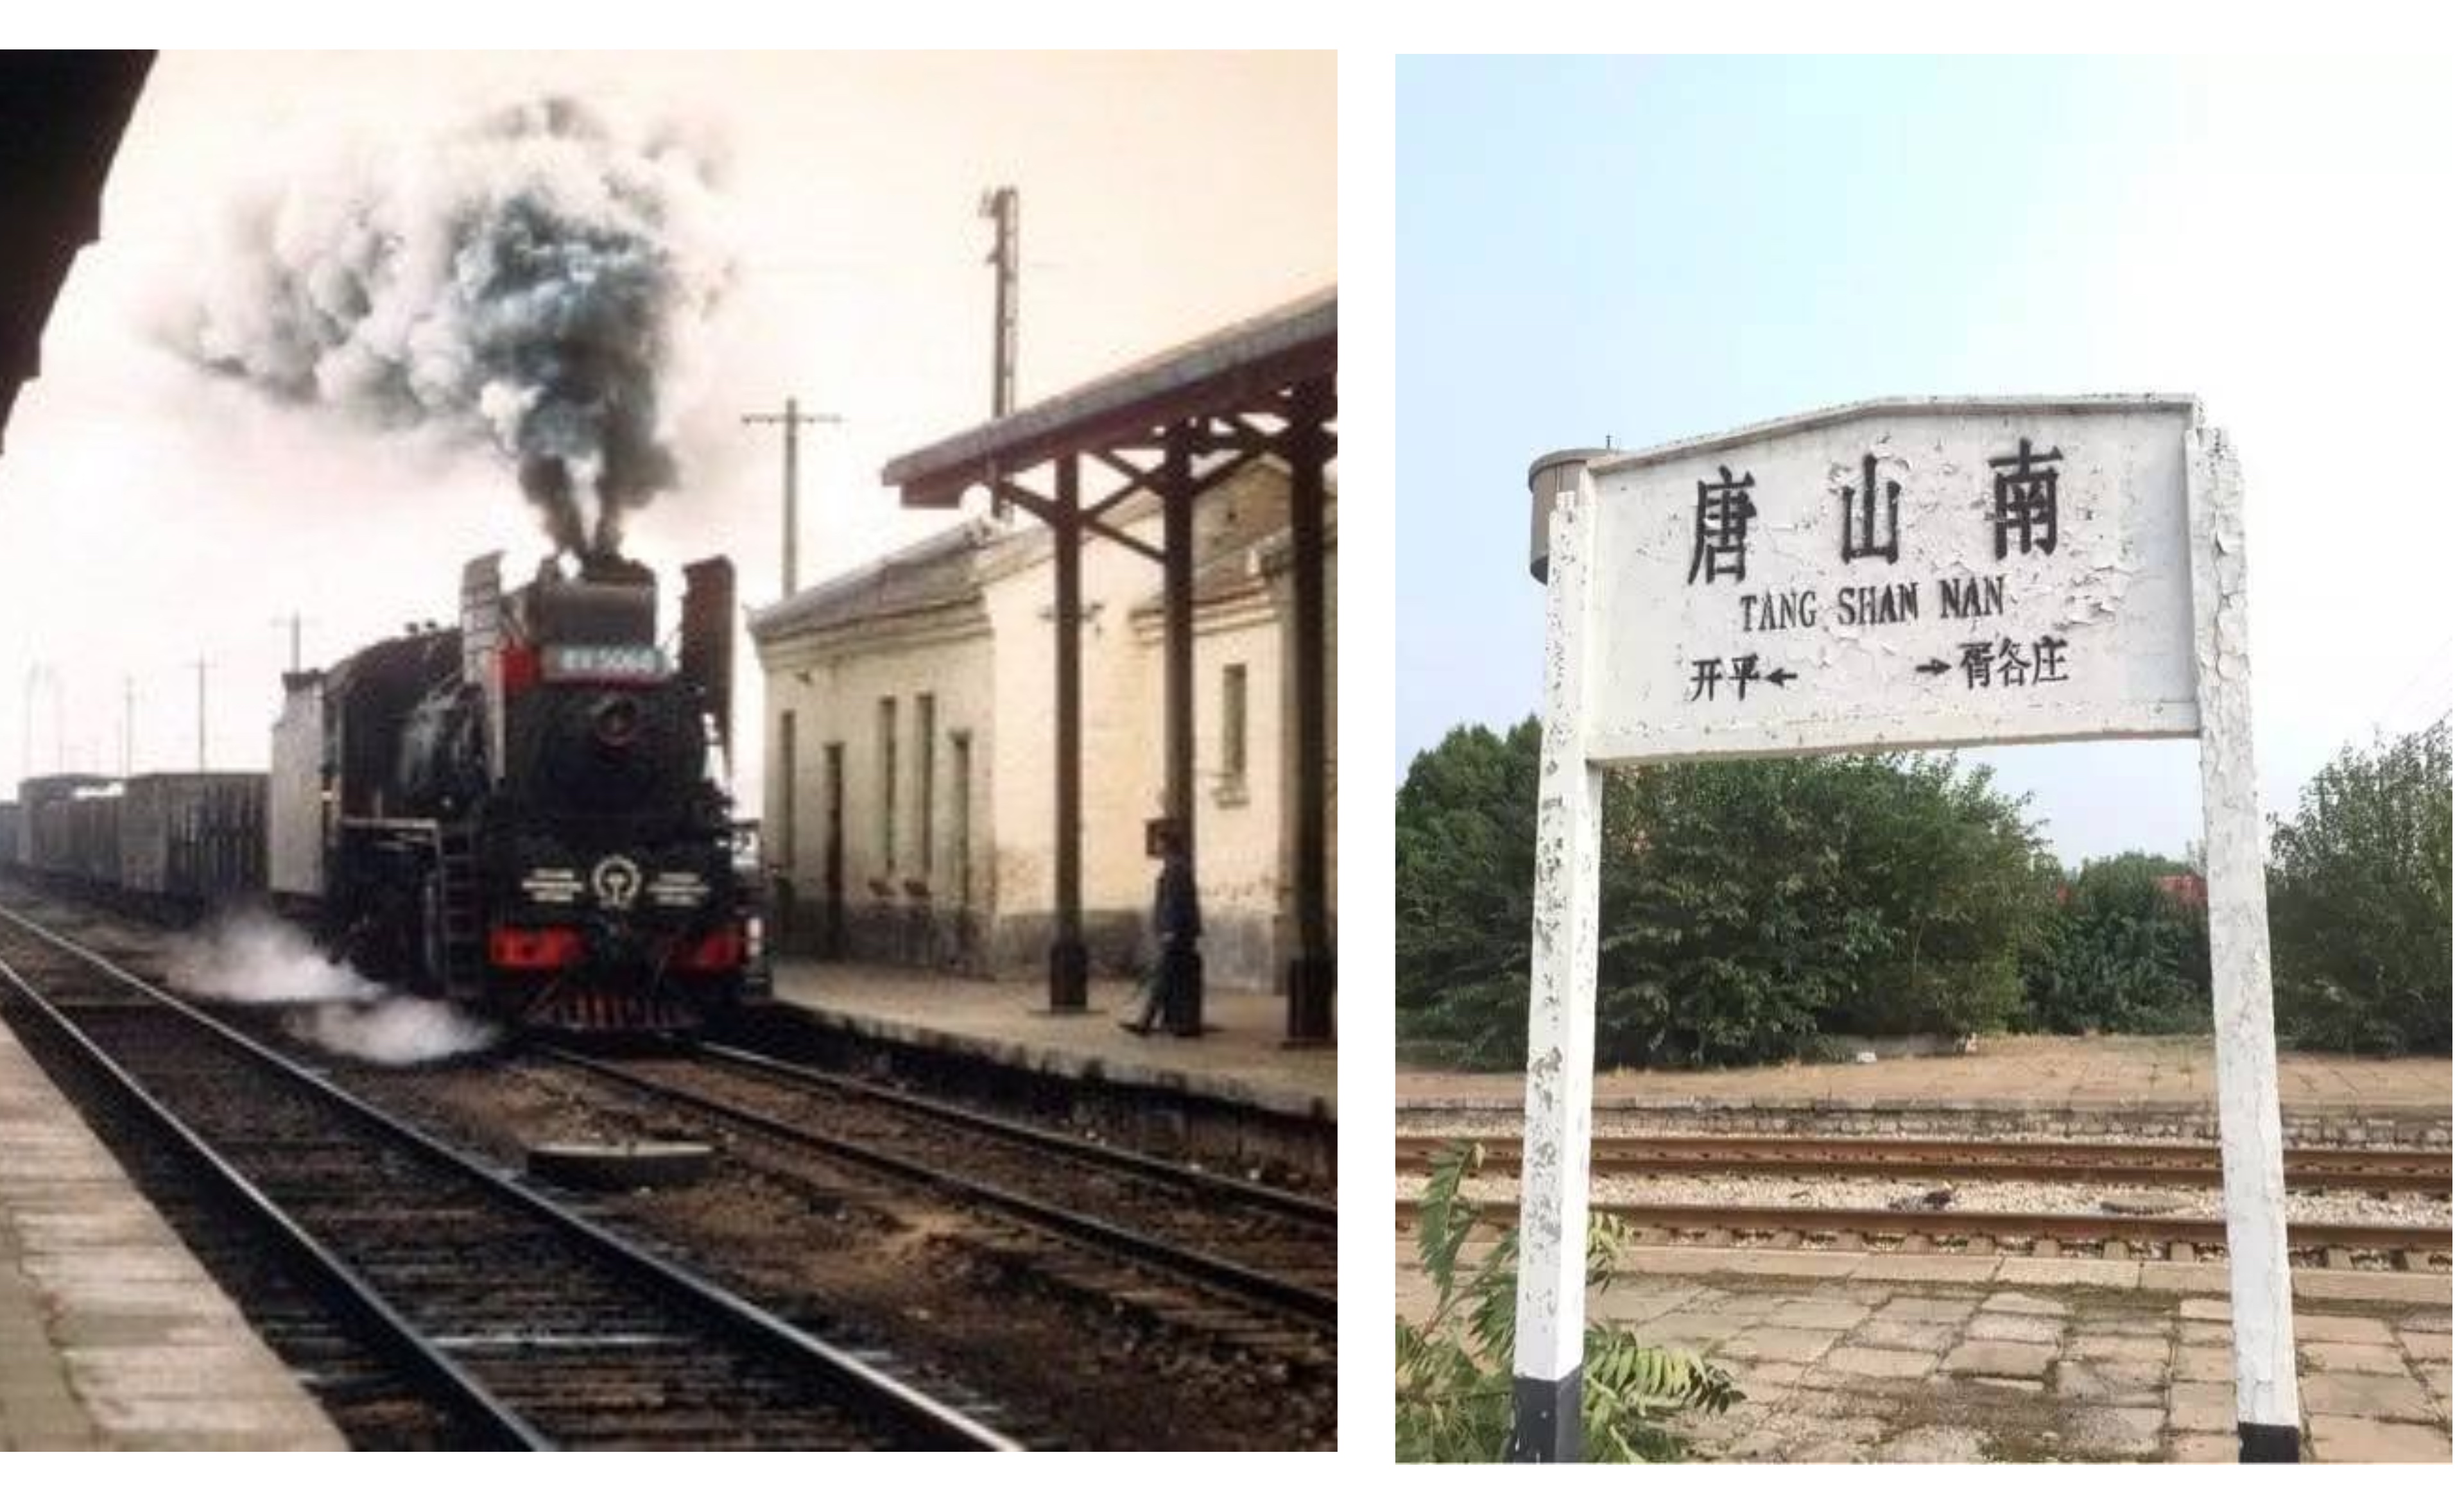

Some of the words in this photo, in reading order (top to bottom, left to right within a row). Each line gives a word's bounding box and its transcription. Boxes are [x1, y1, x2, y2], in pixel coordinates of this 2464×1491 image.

[1687, 436, 2064, 585] 唐山南
[1739, 590, 1818, 632] TANG
[1838, 583, 1920, 626] SHAN
[1939, 576, 2006, 619] NAN
[1691, 653, 1761, 702] 开平
[1959, 635, 2071, 690] 胥各庄
